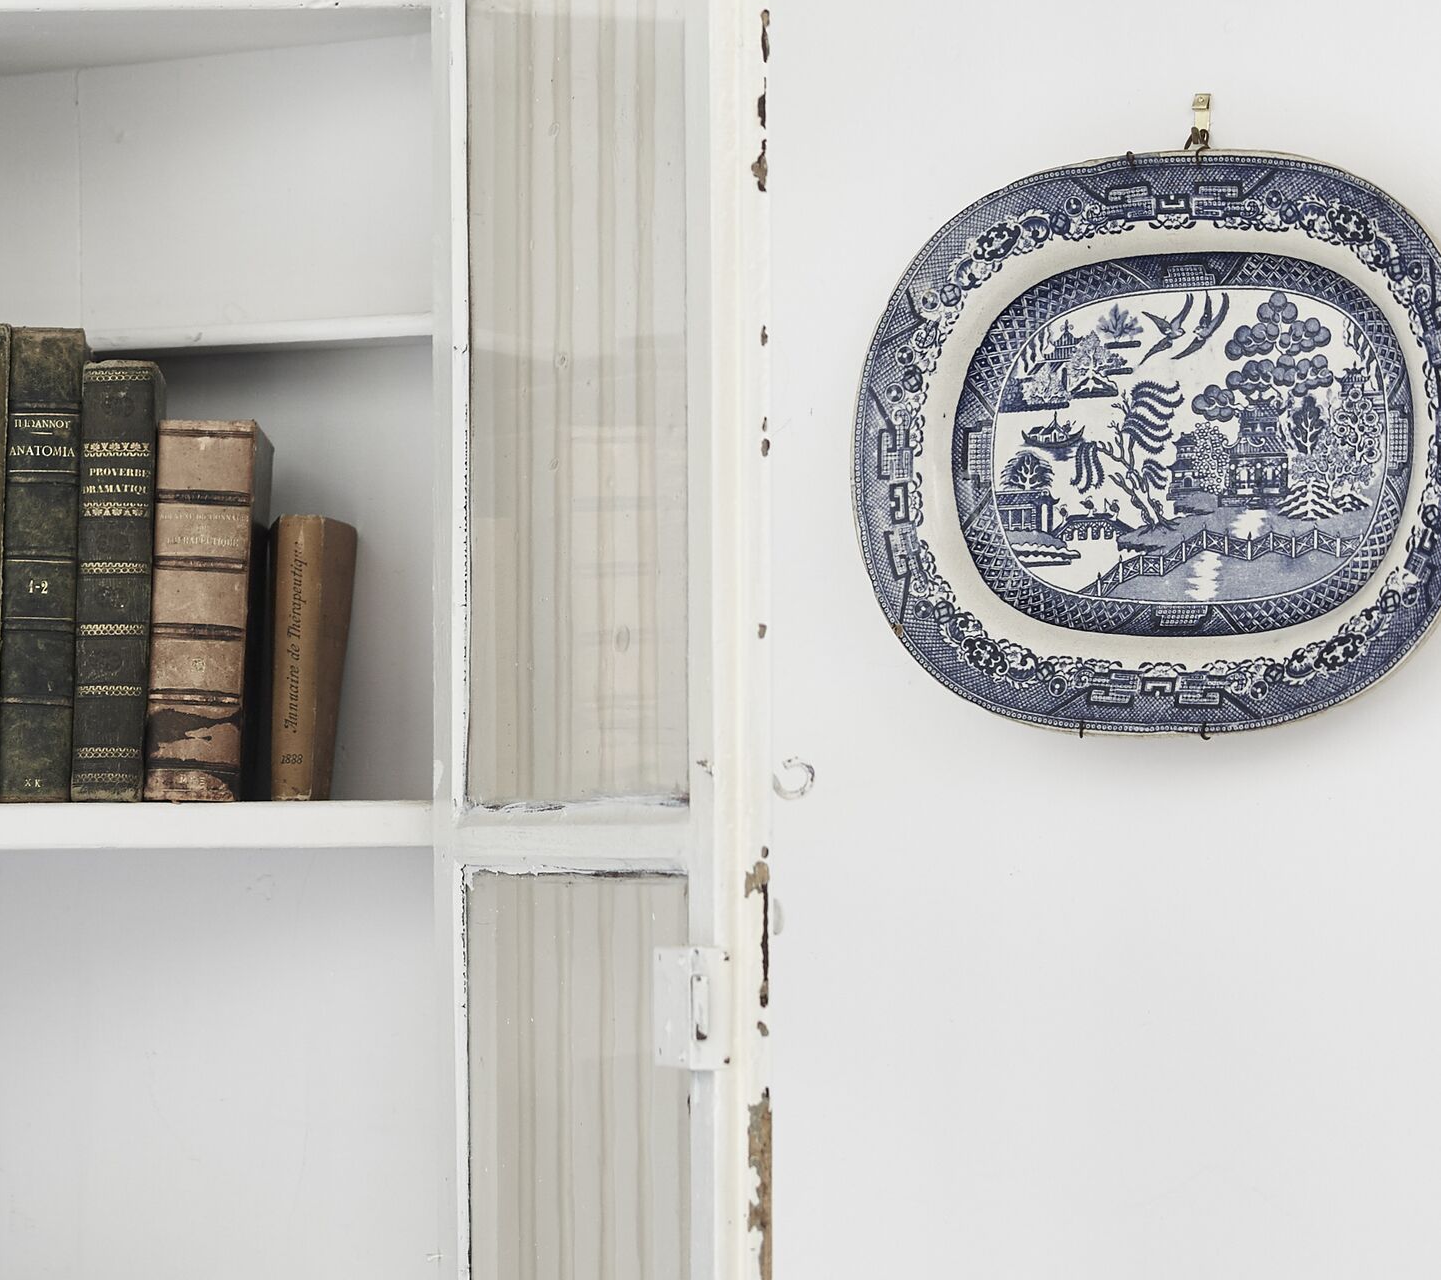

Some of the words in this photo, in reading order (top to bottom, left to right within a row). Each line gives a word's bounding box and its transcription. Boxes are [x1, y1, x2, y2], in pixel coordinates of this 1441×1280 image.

[9, 445, 75, 457] ΑΝΑΤΟΜΙΑ
[89, 468, 151, 477] PROVERBE
[29, 581, 49, 594] 1-2
[289, 642, 301, 661] de
[283, 665, 302, 734] Annuaire
[280, 753, 303, 764] 1888
